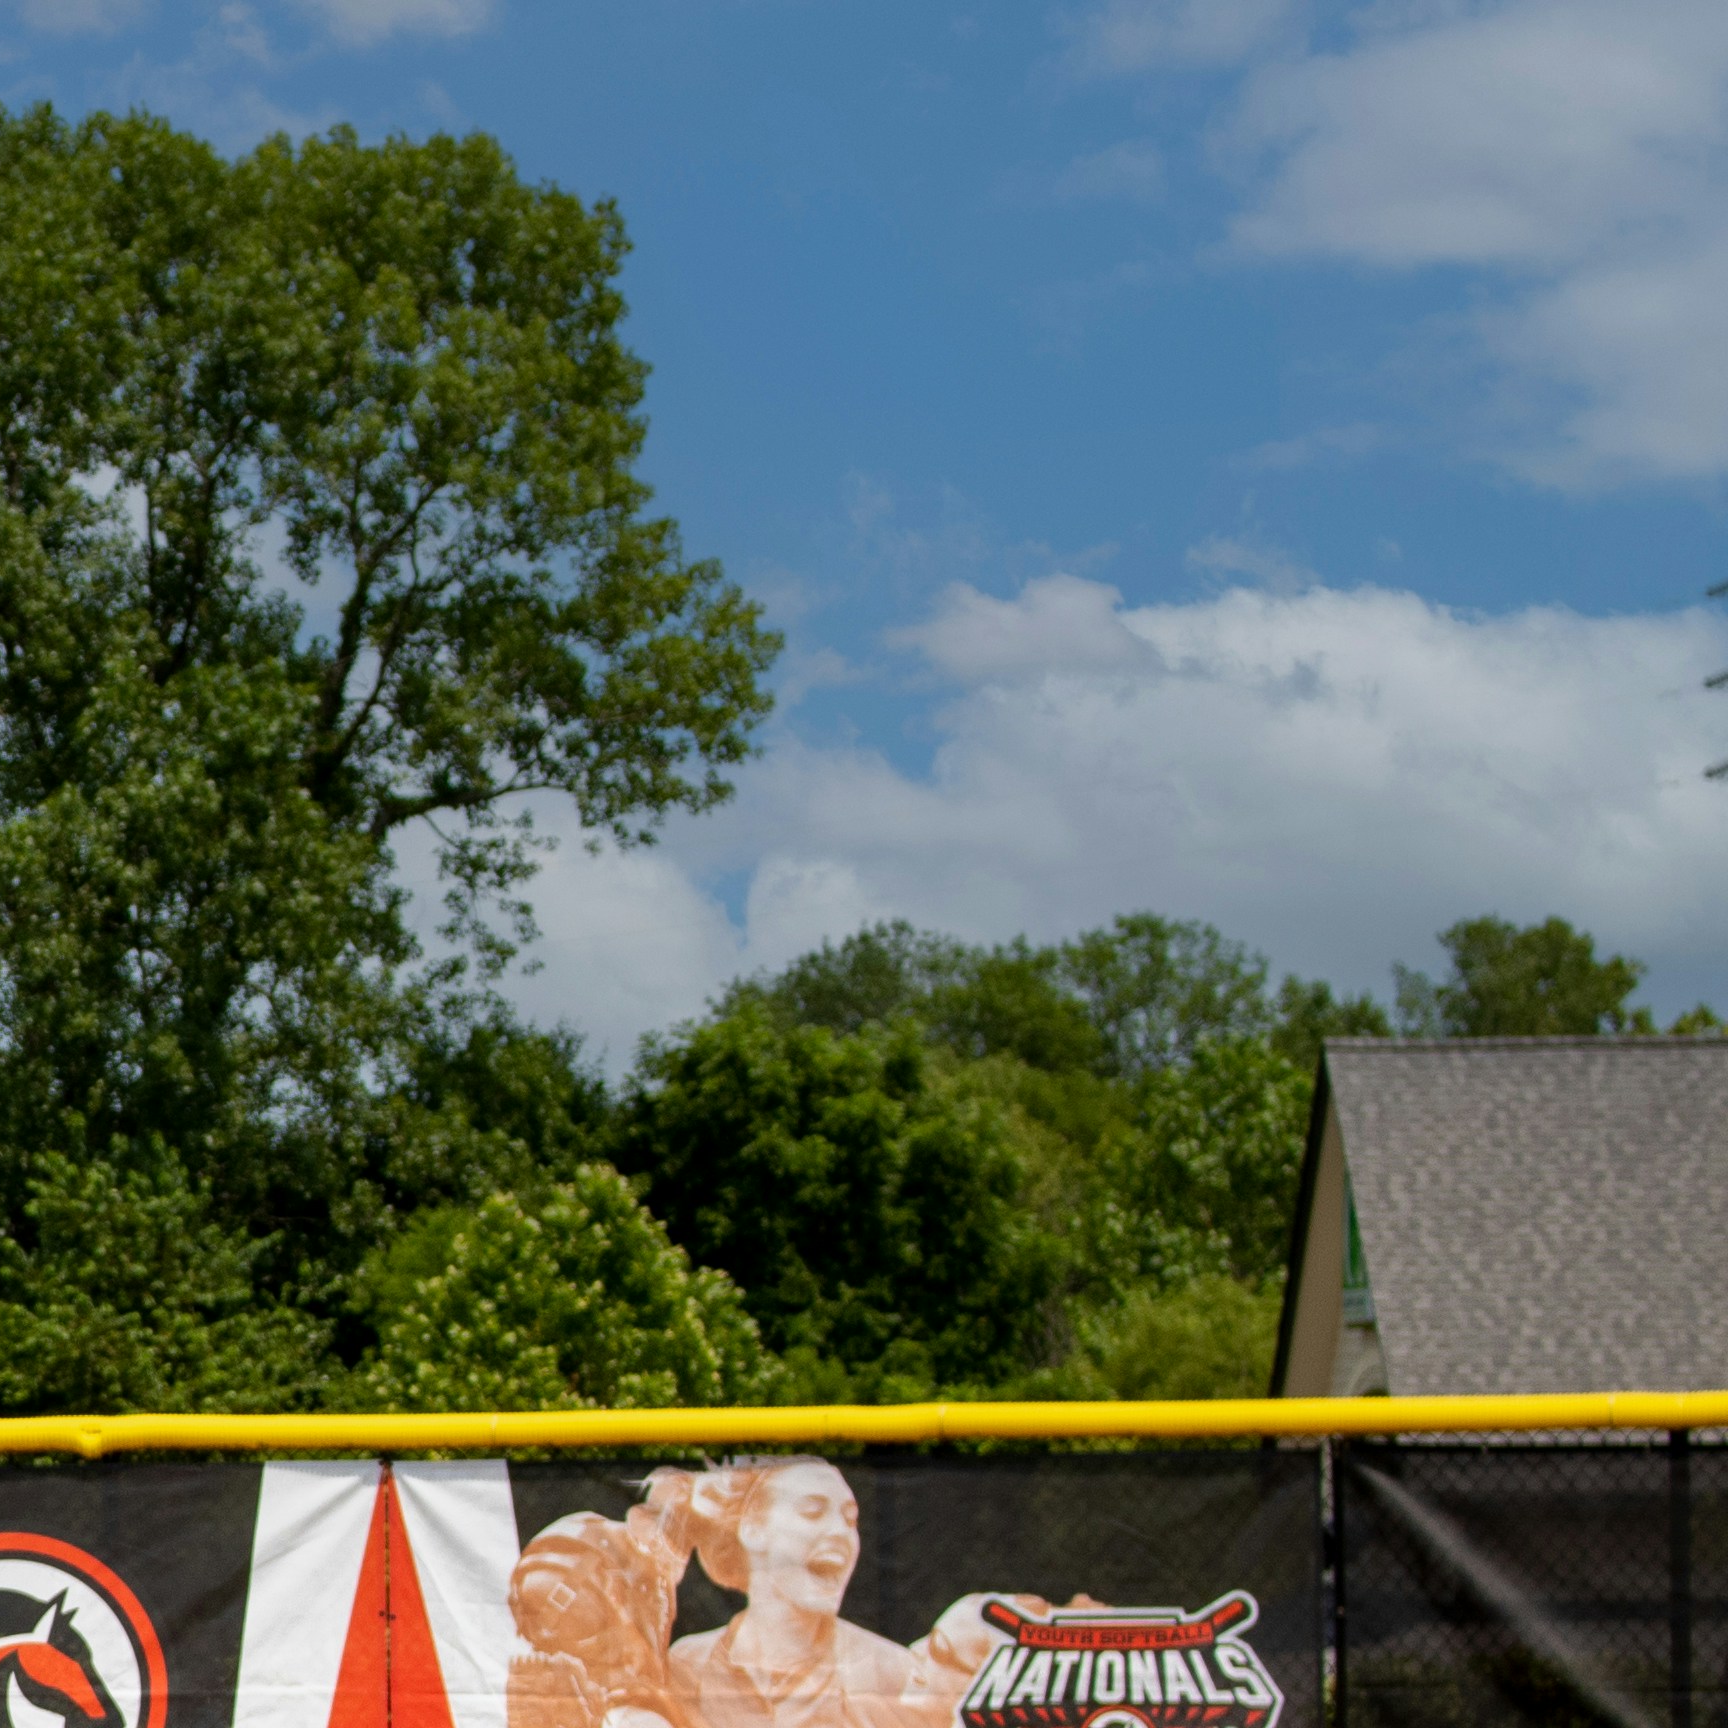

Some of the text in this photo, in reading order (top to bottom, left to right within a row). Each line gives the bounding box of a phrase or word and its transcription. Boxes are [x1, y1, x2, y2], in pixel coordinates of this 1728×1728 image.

[1023, 1627, 1211, 1645] YOUTH SOFTBALL
[965, 1645, 1273, 1710] NATIONALS
